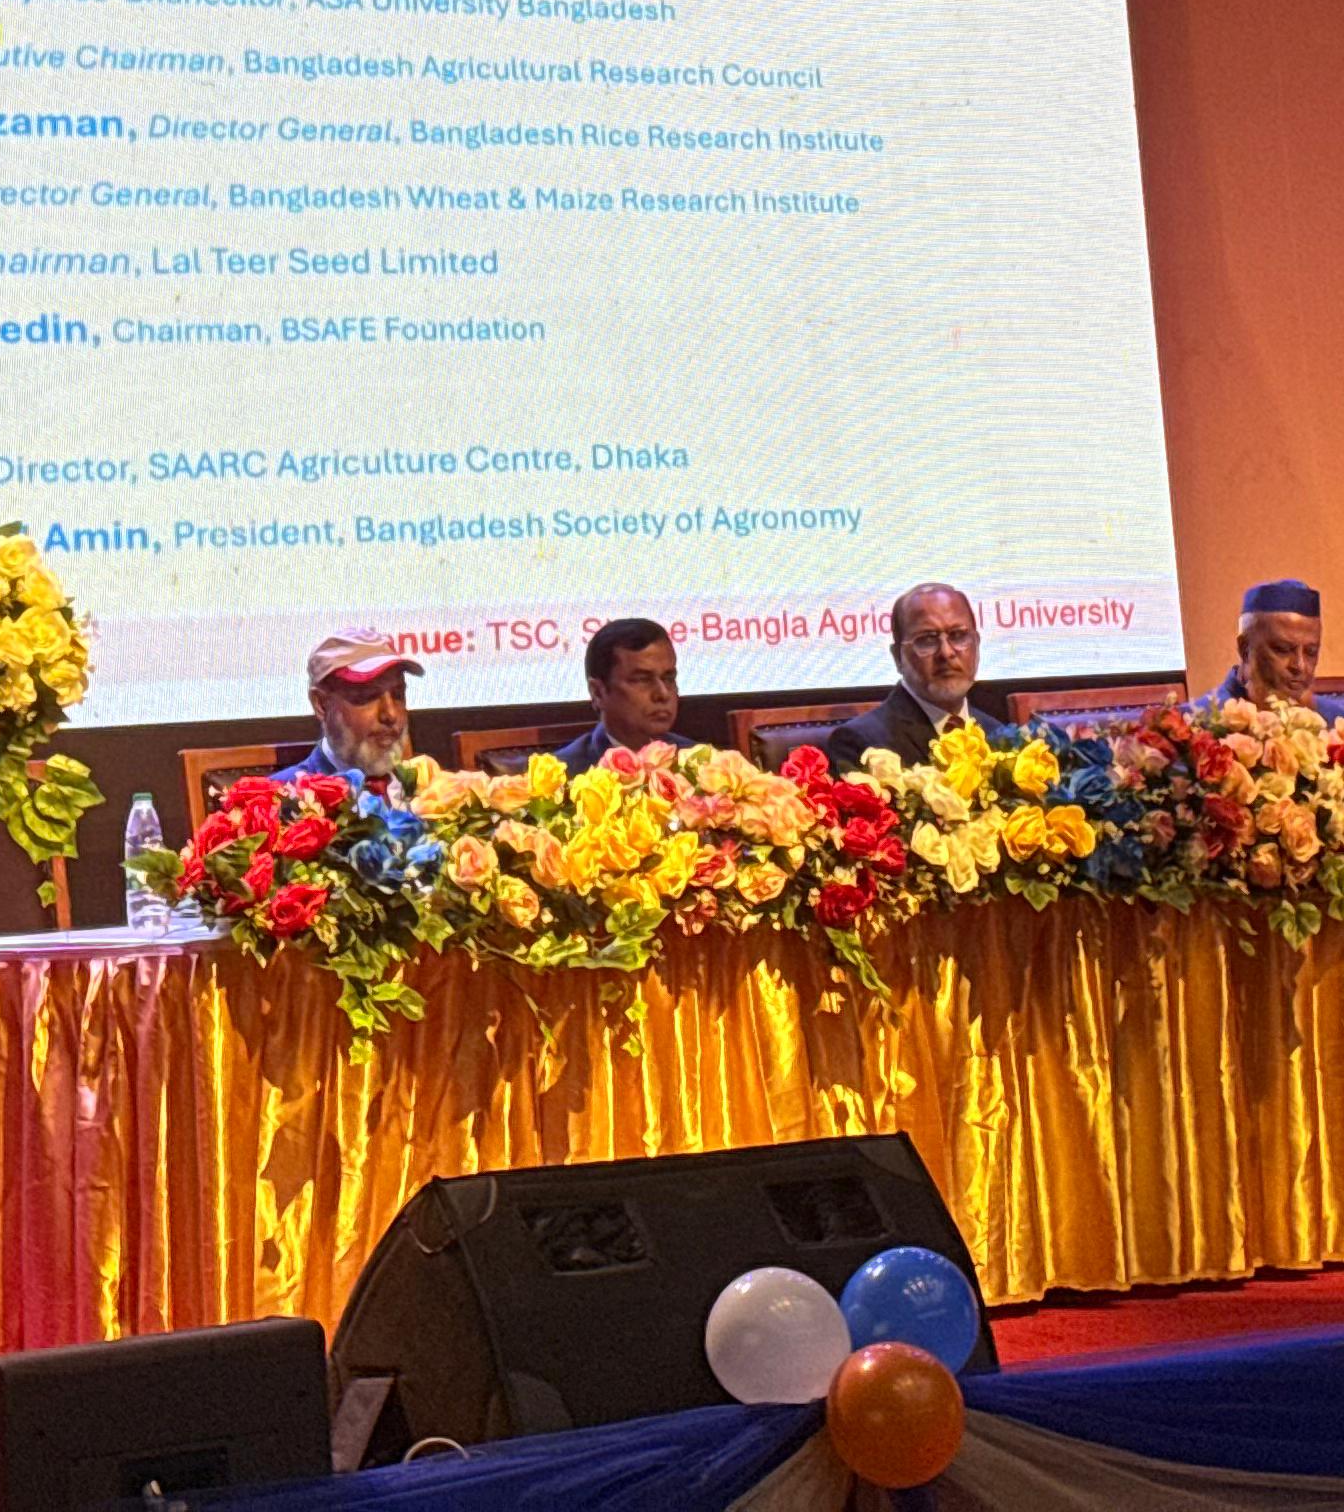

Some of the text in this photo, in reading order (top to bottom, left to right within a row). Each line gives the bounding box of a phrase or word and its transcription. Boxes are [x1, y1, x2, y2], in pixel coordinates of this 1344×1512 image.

[74, 44, 236, 78] Chairman,
[242, 50, 417, 84] Bangladesh
[420, 54, 584, 87] Agricultural
[588, 60, 716, 87] Research
[721, 67, 824, 90] Council
[148, 114, 266, 141] Director
[276, 116, 402, 146] General,
[409, 119, 574, 150] Bangladesh
[580, 123, 640, 147] Rice
[647, 125, 771, 150] Research
[779, 131, 883, 151] Institute
[90, 181, 218, 212] General,
[228, 183, 400, 213] Bangladesh
[407, 186, 499, 210] Wheat
[507, 188, 527, 211] &
[535, 187, 614, 211] Maize
[621, 187, 746, 211] Research
[753, 190, 861, 216] Institute
[152, 249, 200, 275] Lal
[213, 247, 278, 276] Teer
[288, 248, 371, 275] Seed
[381, 250, 499, 274] Limited
[112, 319, 272, 348] Chairman,
[281, 317, 376, 343] BSAFE
[385, 317, 545, 341] Foundation
[148, 450, 267, 481] SAARC
[277, 450, 458, 482] Agriculture
[465, 445, 581, 474] Centre,
[591, 443, 690, 471] Dhaka
[43, 520, 163, 554] Amin,
[173, 520, 345, 548] President,
[354, 512, 546, 547] Bangladesh
[552, 509, 667, 539] Society
[674, 506, 704, 535] of
[711, 506, 862, 539] Agronomy
[486, 618, 570, 654] TSC,
[994, 596, 1136, 631] University
